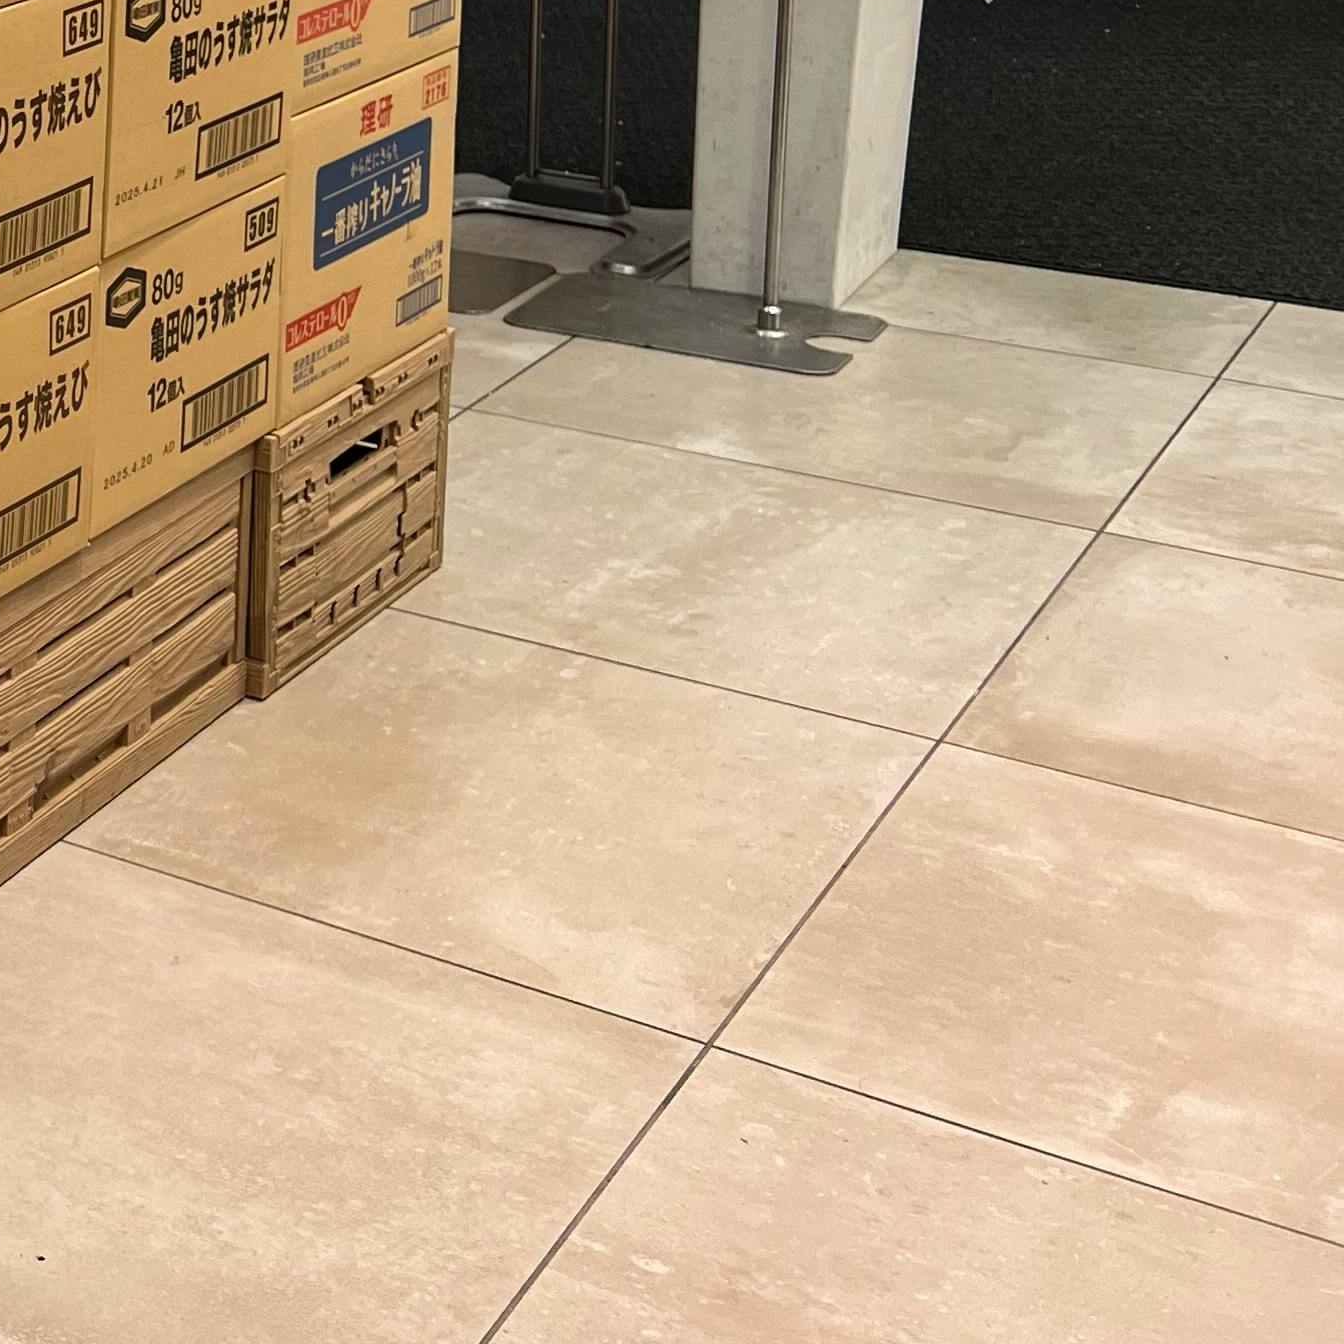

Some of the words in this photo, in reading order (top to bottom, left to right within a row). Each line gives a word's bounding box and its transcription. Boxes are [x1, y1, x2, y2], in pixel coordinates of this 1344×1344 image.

[67, 5, 100, 50] 649
[425, 82, 447, 105] 2176
[164, 97, 201, 136] 12個入
[360, 94, 394, 136] 理研
[114, 175, 164, 207] 2025.4.21
[321, 157, 423, 246] 一番搾りキャノーラ油
[247, 206, 276, 242] 509
[151, 267, 184, 305] 80g
[53, 303, 86, 350] 649
[148, 258, 276, 364] 亀田のうす焼サラダ
[147, 375, 186, 414] 12個入
[102, 454, 154, 492] 2025.4.20
